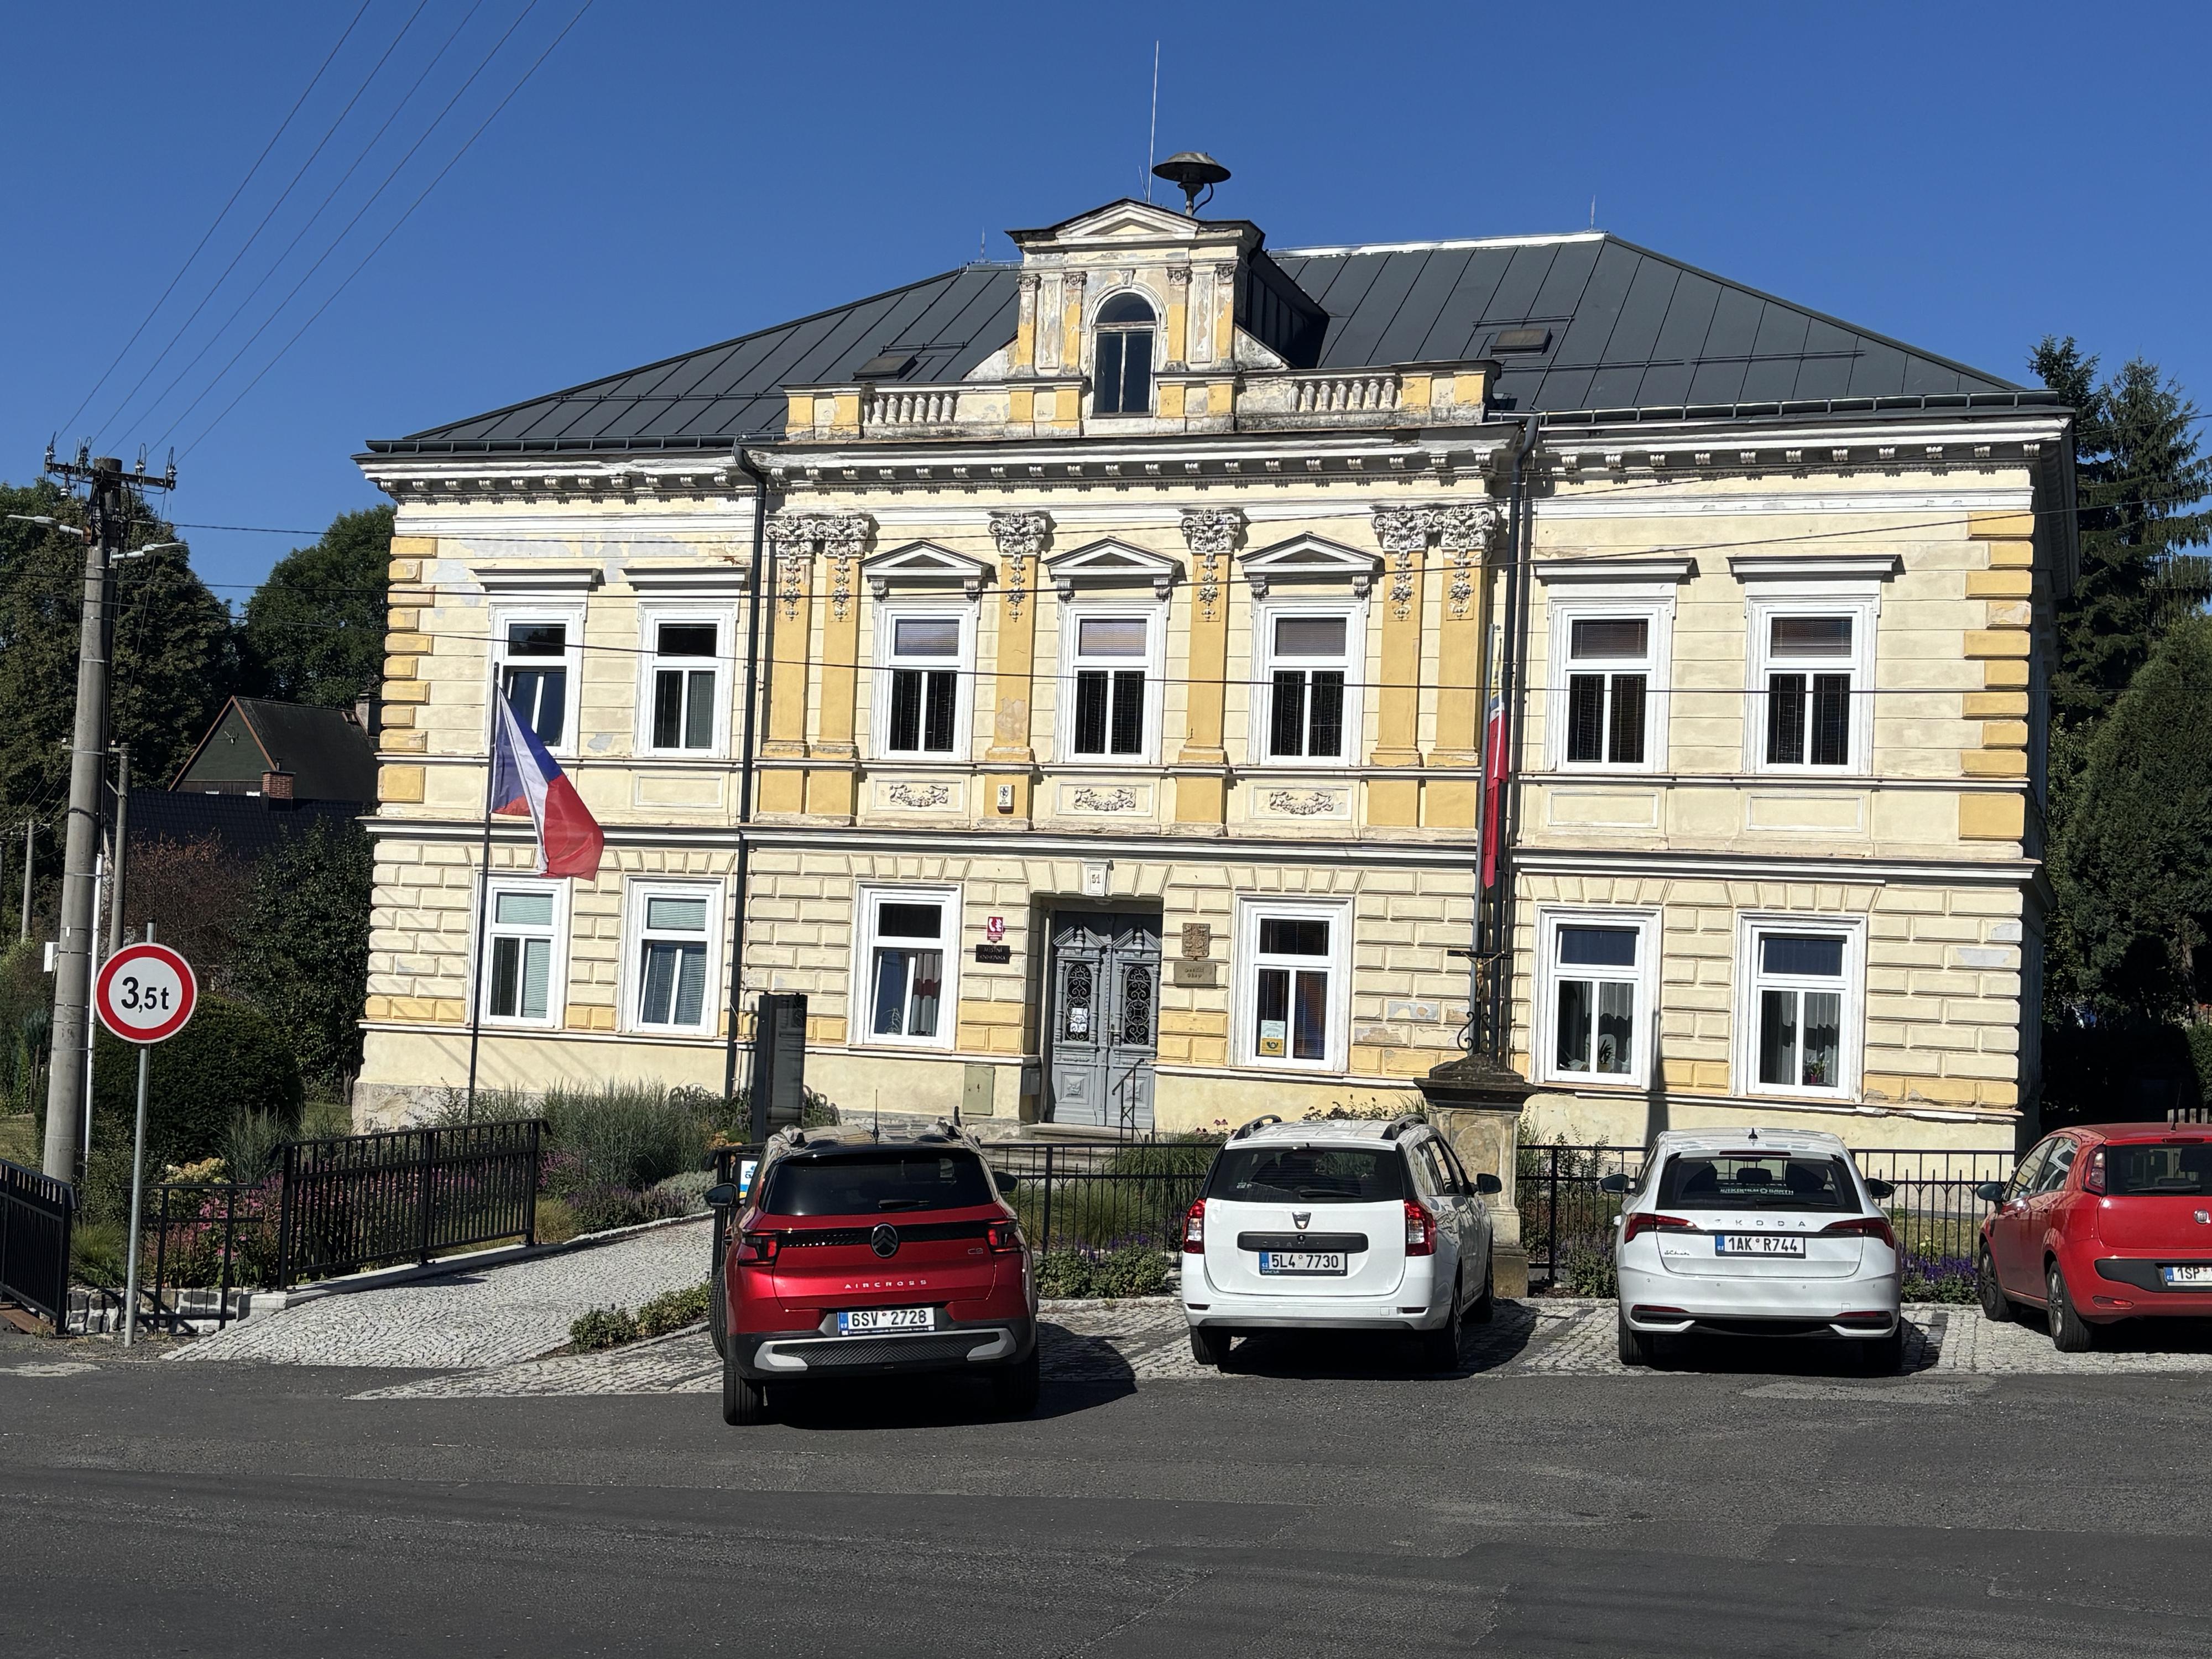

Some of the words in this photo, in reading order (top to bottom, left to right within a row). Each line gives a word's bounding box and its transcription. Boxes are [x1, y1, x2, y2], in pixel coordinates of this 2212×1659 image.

[1091, 874, 1101, 884] 51
[1729, 1238, 1752, 1251] 1AK
[1764, 1238, 1798, 1252] R744
[1271, 1254, 1296, 1268] 5L4
[1306, 1255, 1339, 1268] 7730
[2177, 1266, 2200, 1280] 1SP
[844, 1280, 927, 1289] AIRCROSS
[852, 1312, 879, 1327] 6SV
[891, 1310, 927, 1326] 2728
